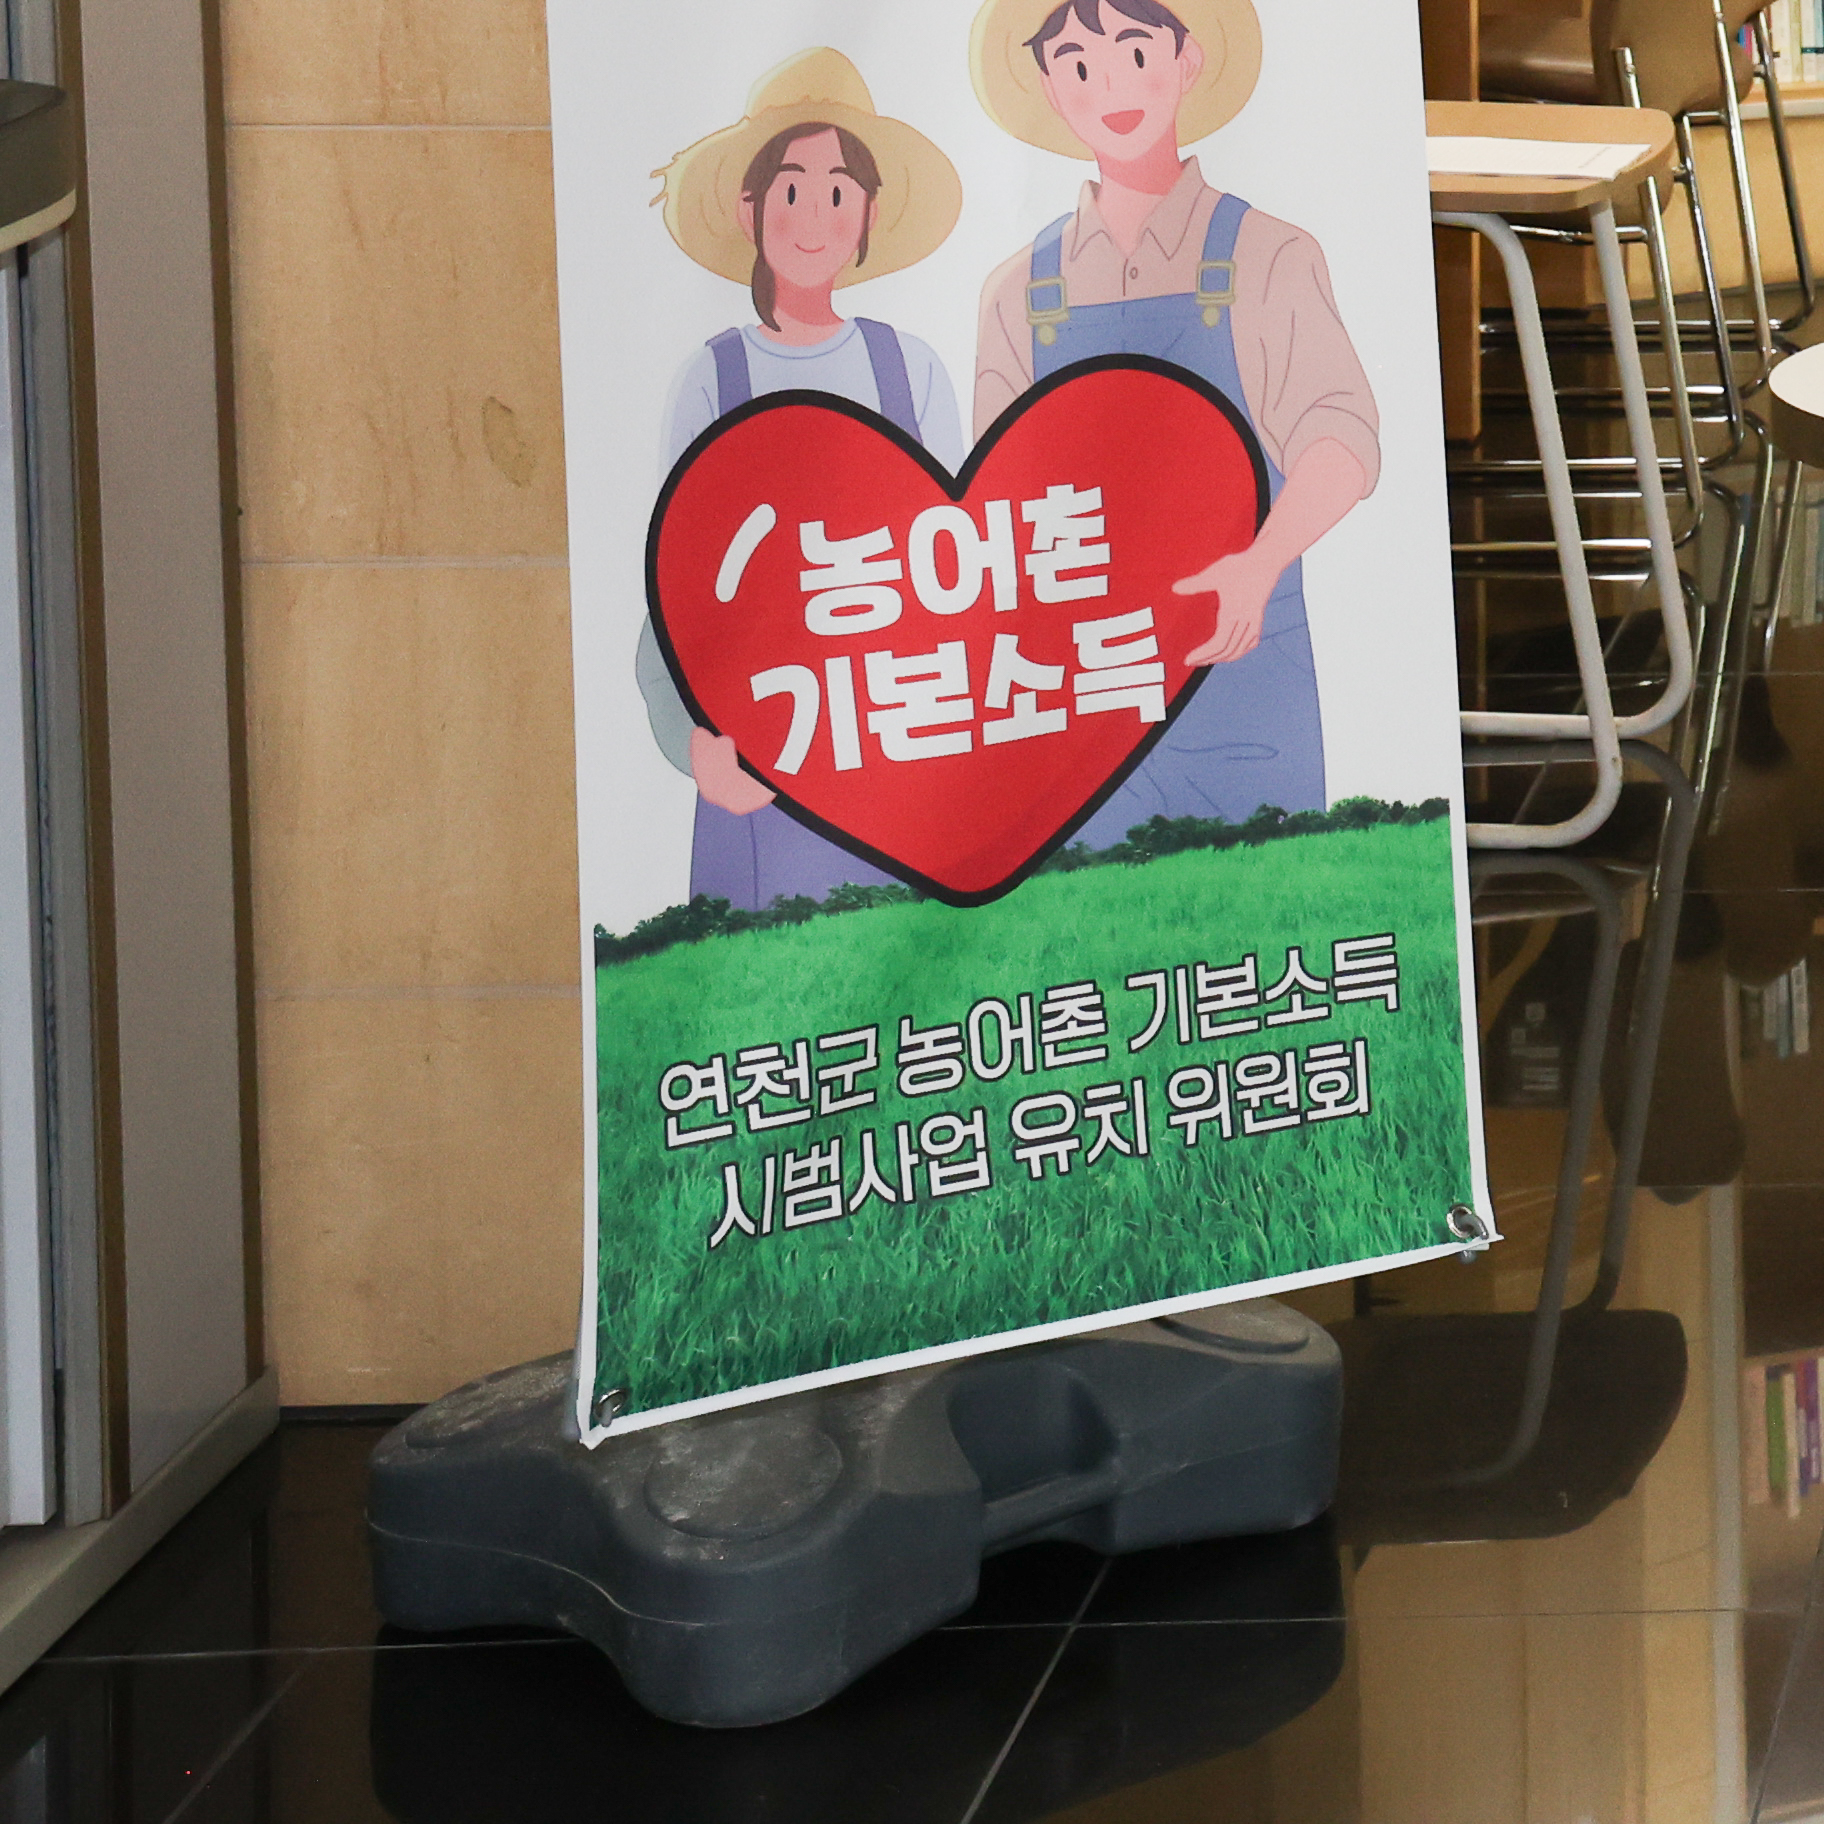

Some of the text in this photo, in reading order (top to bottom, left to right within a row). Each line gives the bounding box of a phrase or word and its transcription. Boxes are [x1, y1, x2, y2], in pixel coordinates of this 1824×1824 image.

[799, 484, 1111, 636] 농어촌
[751, 608, 1167, 775] 기본소득
[659, 933, 1400, 1150] 연천군 농어촌 기본소득
[710, 1040, 1370, 1249] 시범사업 유치 위원회
